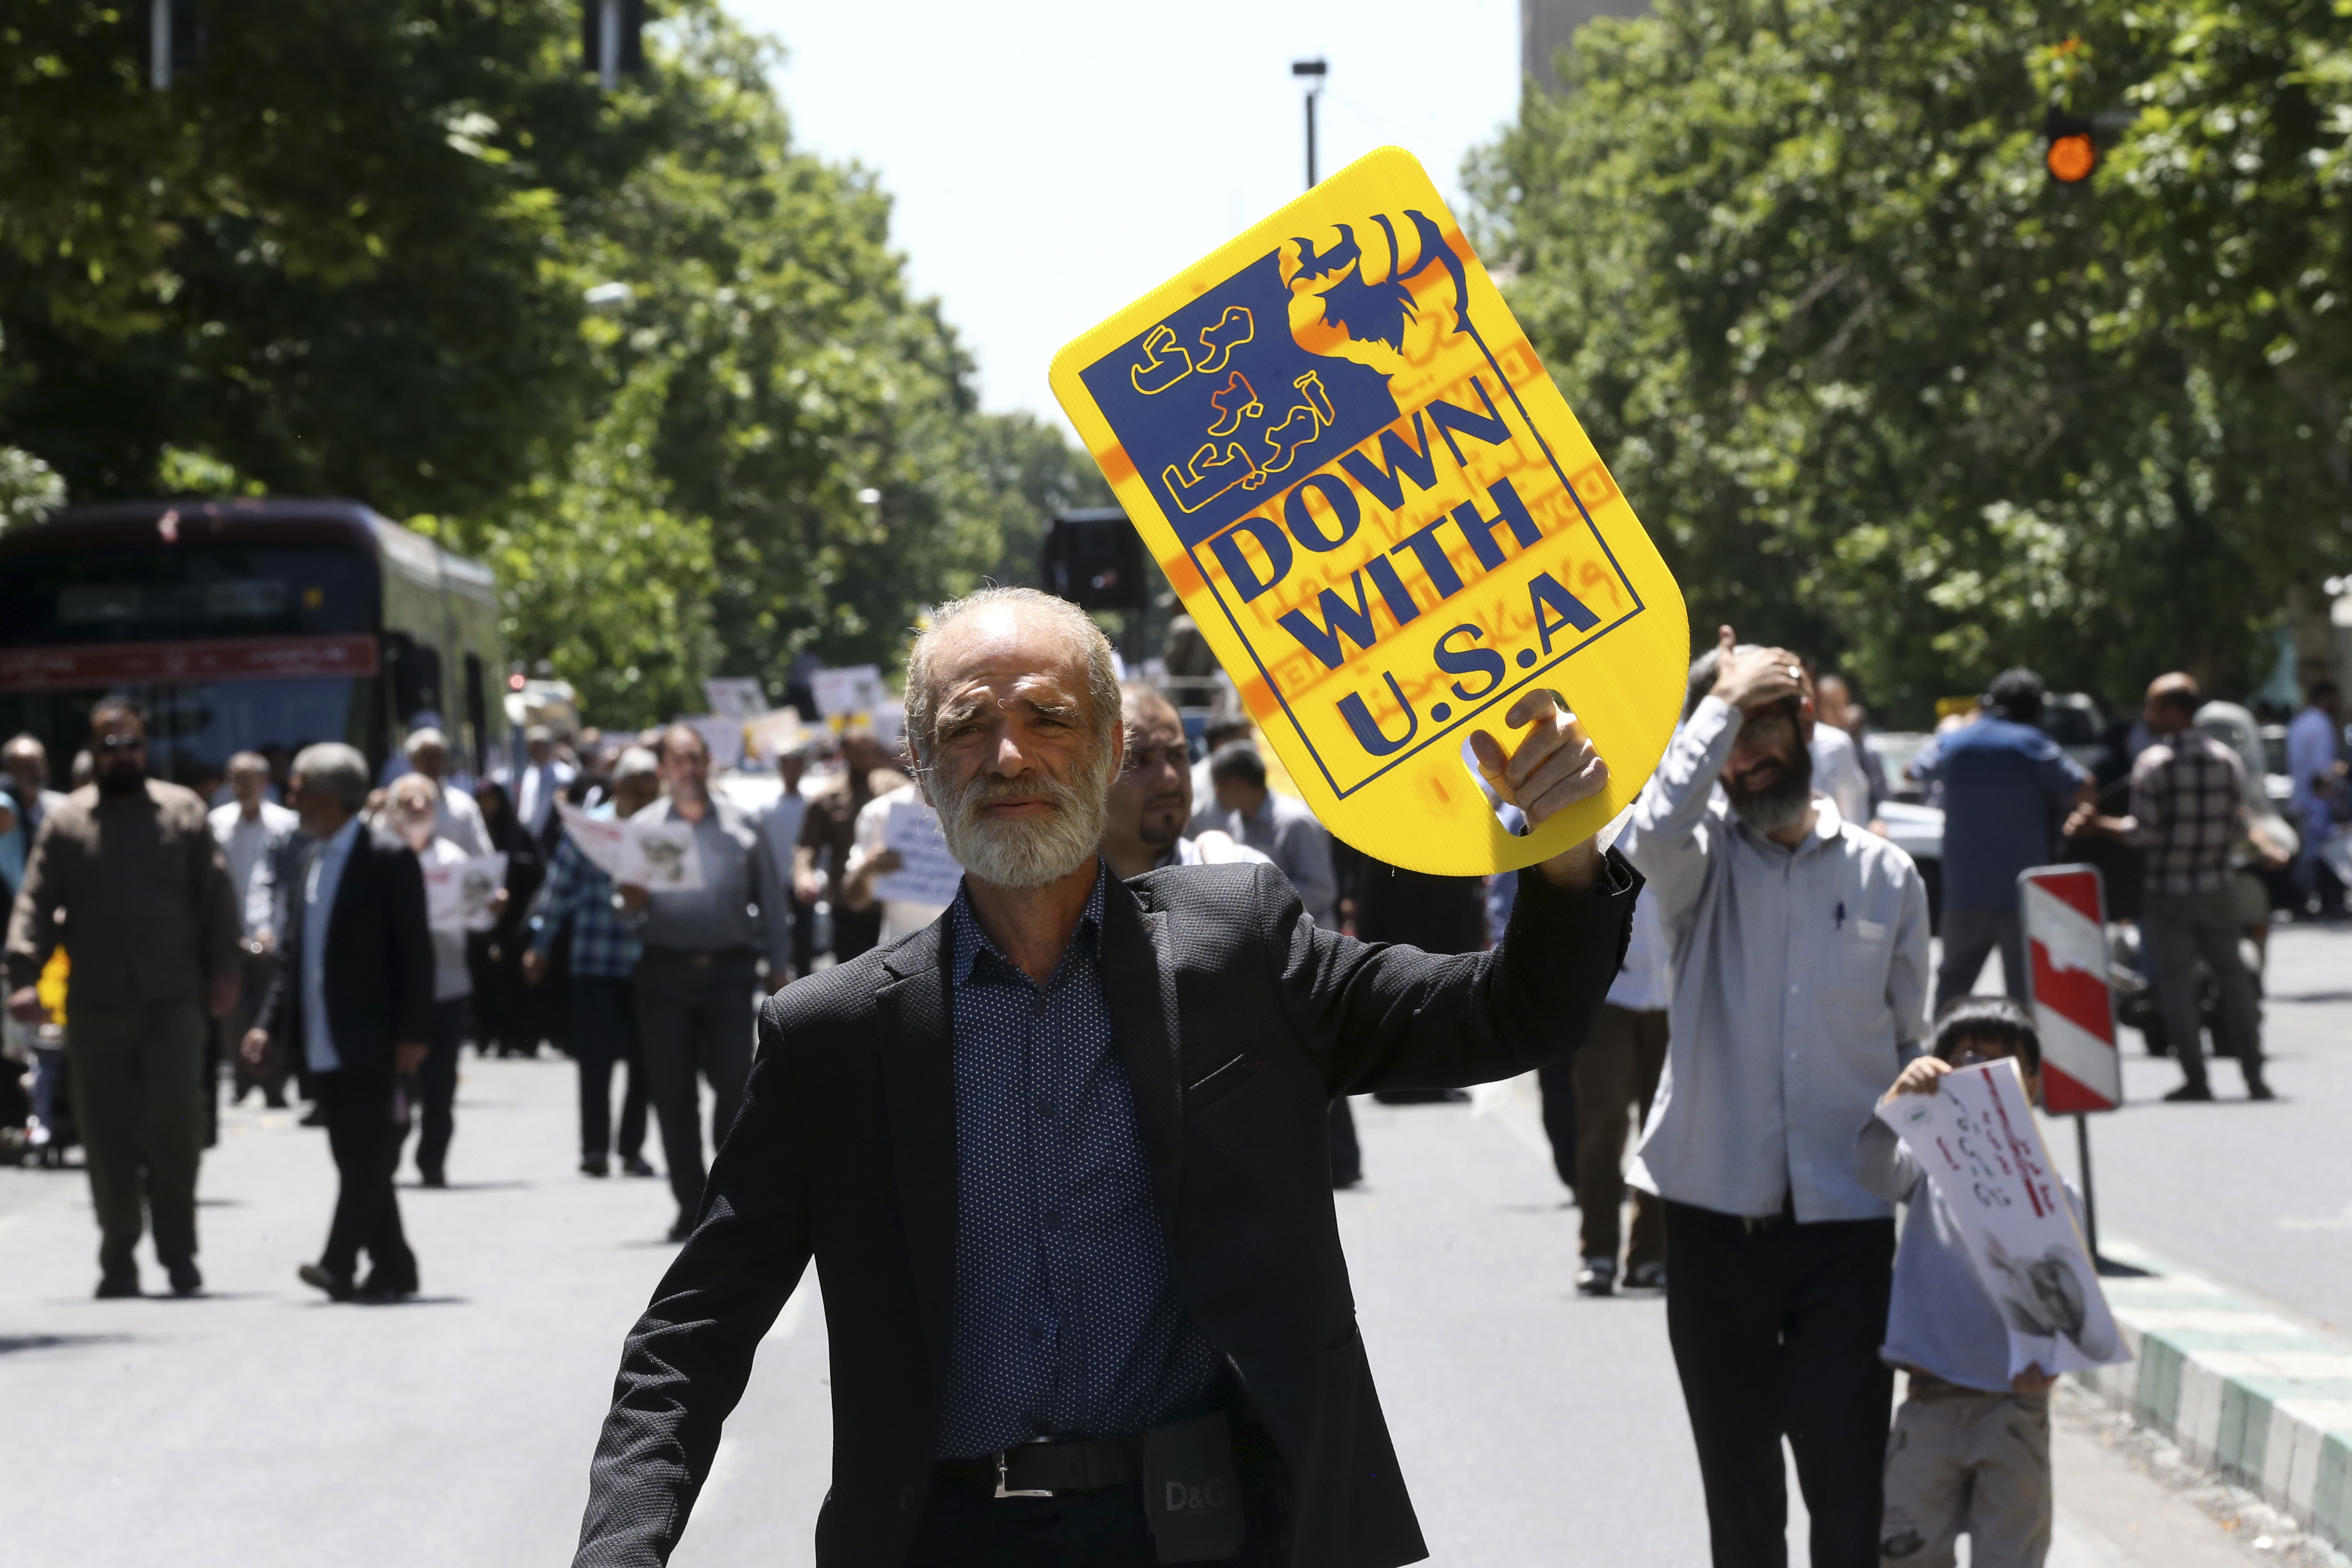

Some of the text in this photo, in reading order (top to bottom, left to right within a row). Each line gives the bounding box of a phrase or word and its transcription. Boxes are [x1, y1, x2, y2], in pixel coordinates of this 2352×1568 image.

[1131, 306, 1254, 395] مرگ
[1207, 371, 1264, 437] بر
[1162, 370, 1335, 513] آمریکا
[1208, 376, 1512, 604] DOWN
[1278, 478, 1542, 670] WITH
[1338, 573, 1600, 756] U.S.A
[1166, 1478, 1227, 1511] D&G
